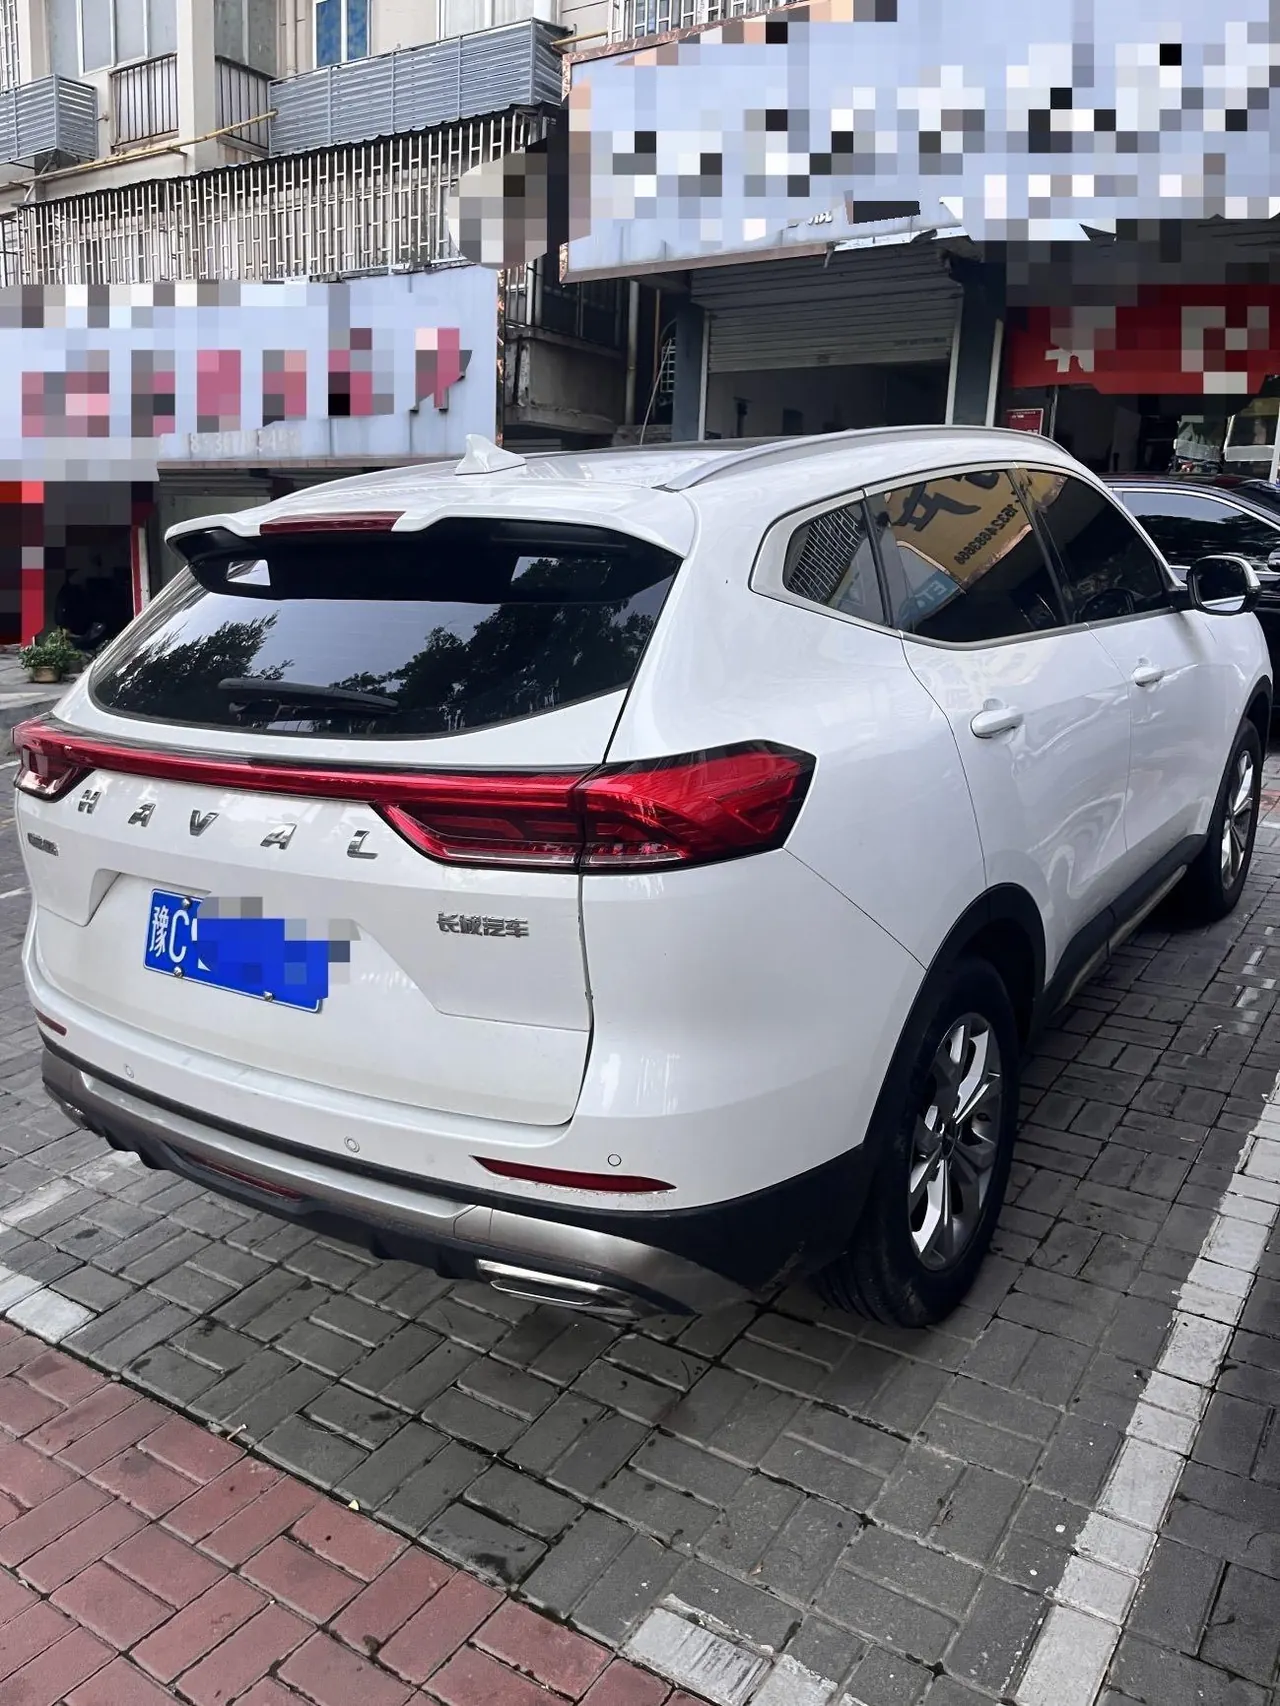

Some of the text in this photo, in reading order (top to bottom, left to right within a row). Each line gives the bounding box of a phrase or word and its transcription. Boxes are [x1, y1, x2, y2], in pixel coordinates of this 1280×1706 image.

[78, 789, 378, 859] HAVAL
[437, 911, 529, 938] 长城汽车
